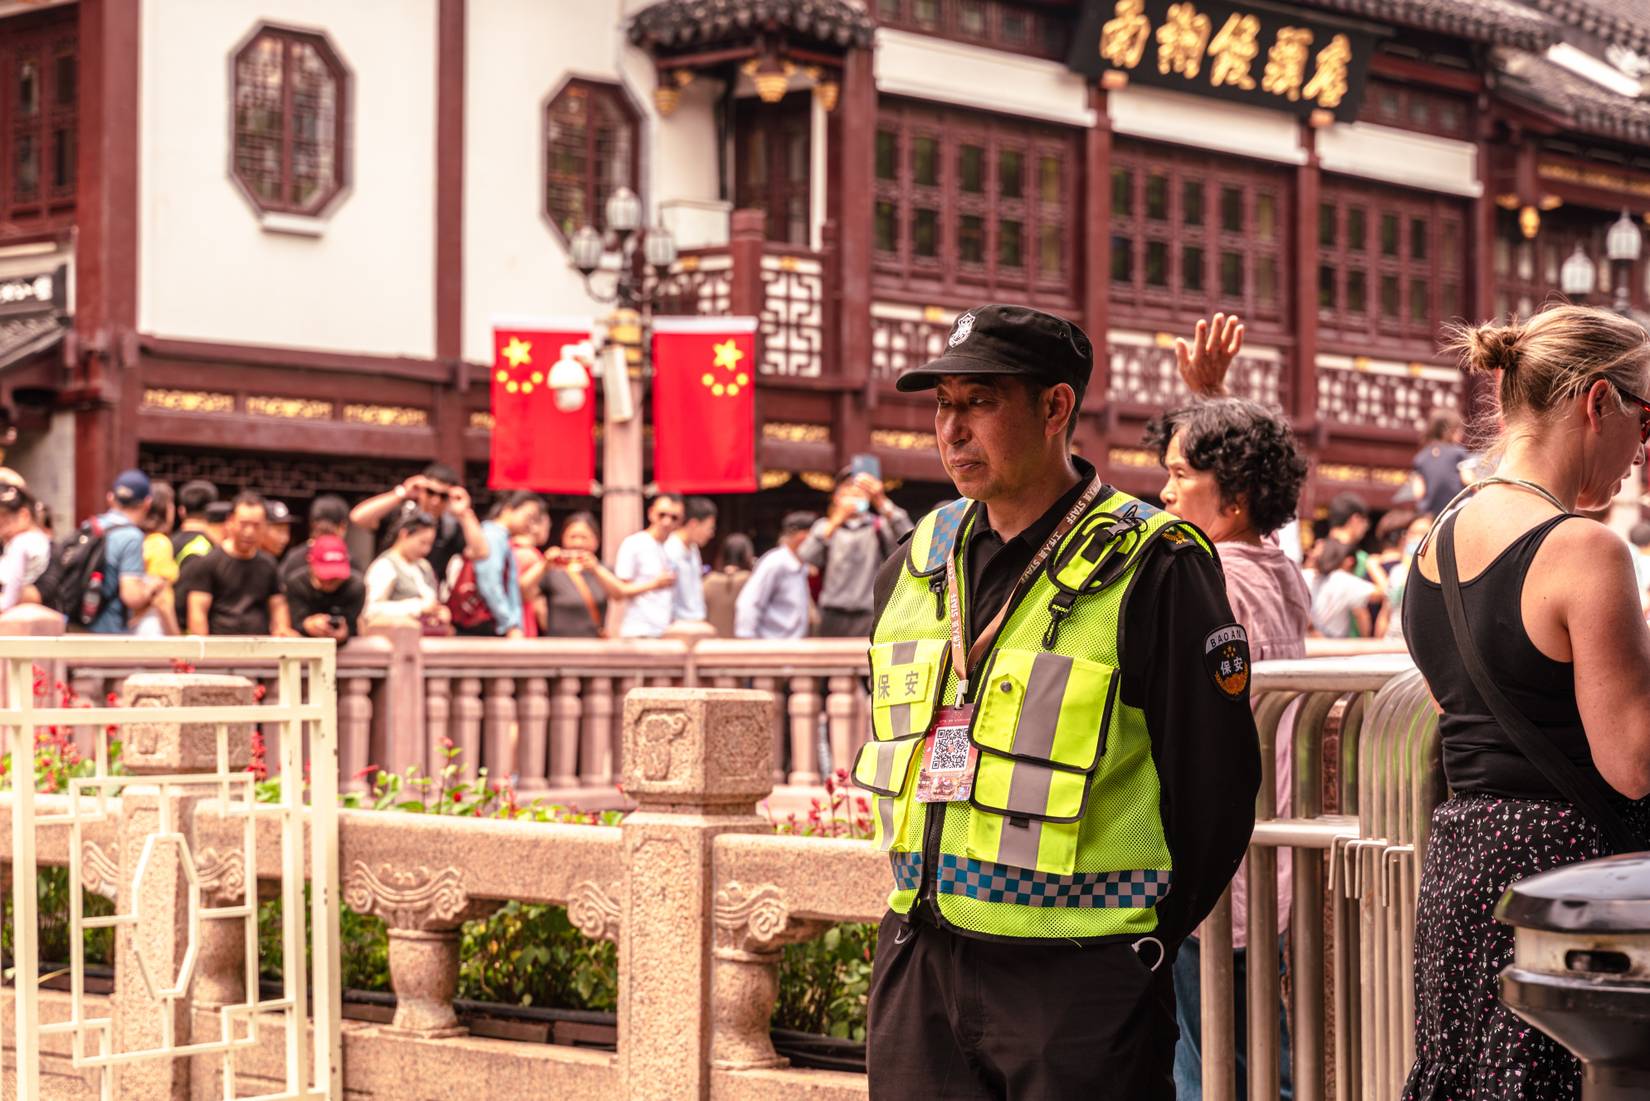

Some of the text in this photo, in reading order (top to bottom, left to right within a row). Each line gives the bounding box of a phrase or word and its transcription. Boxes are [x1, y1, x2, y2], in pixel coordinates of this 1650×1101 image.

[1066, 500, 1086, 525] STAFF
[950, 592, 959, 617] STAFF
[1210, 629, 1242, 647] BAOAN
[1221, 656, 1243, 676] 保安
[878, 670, 919, 700] 保安
